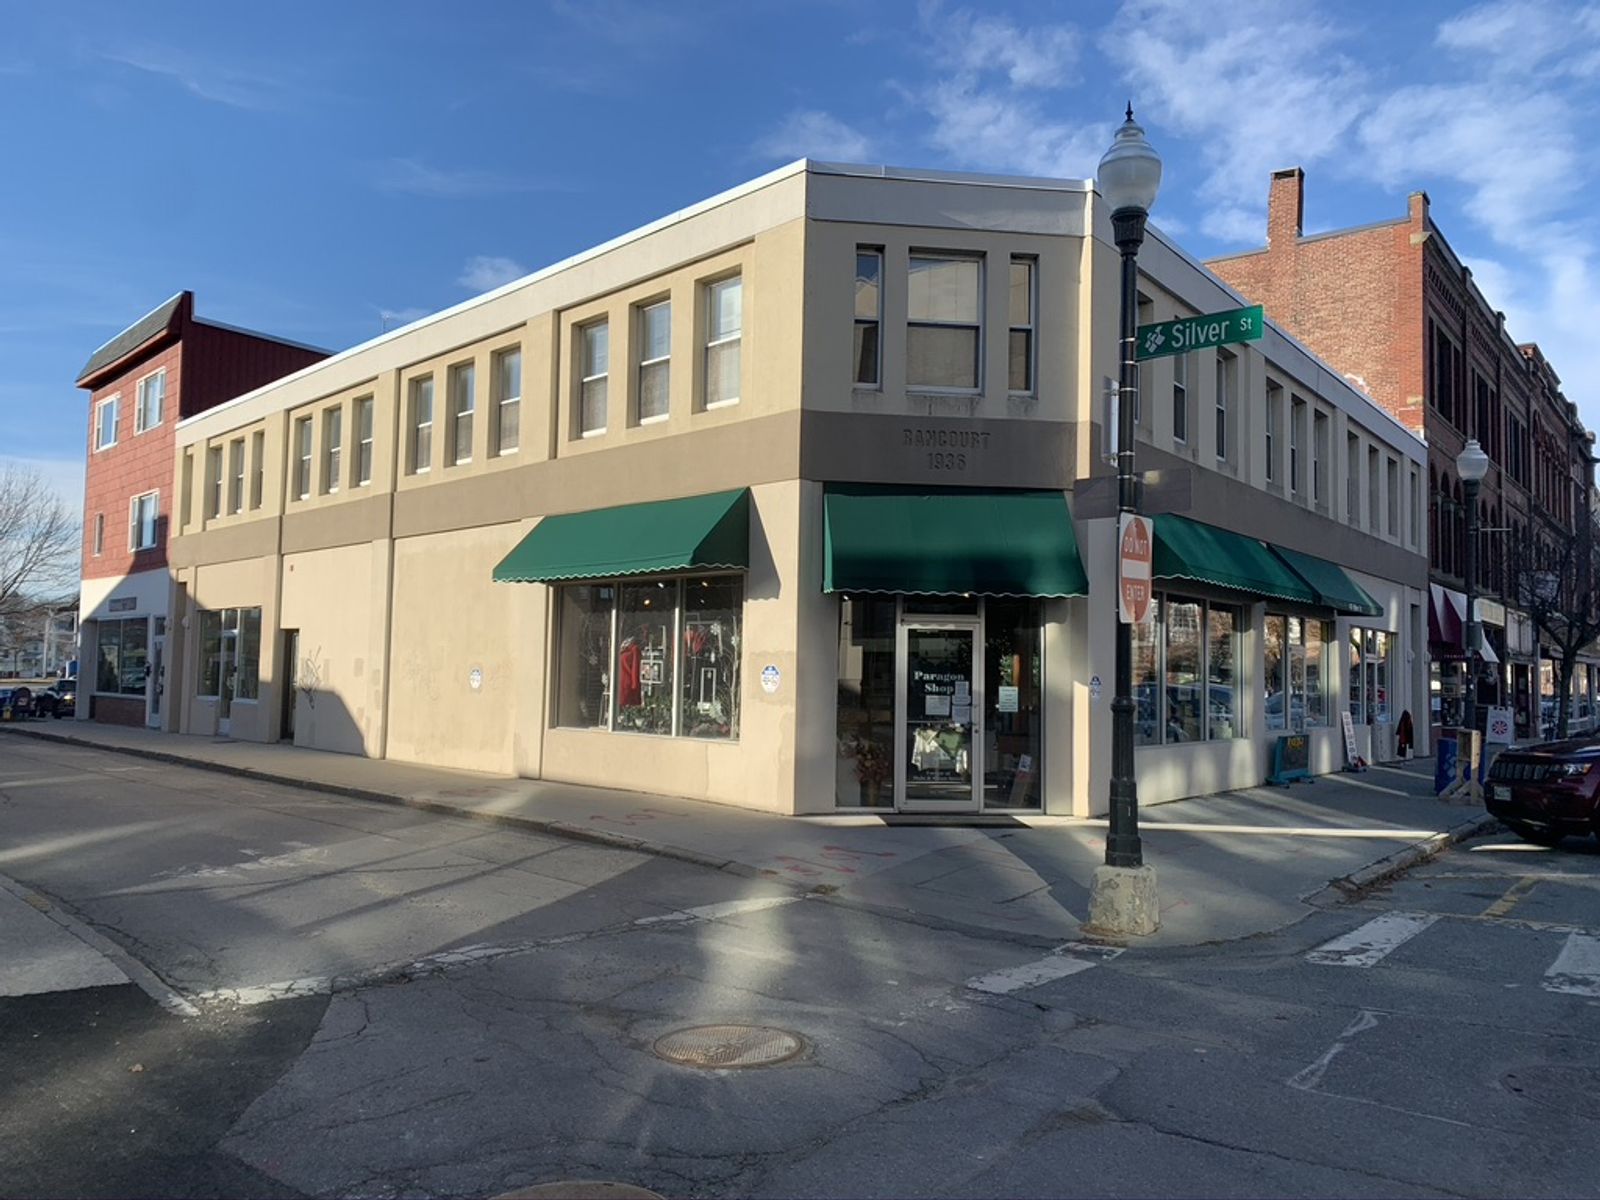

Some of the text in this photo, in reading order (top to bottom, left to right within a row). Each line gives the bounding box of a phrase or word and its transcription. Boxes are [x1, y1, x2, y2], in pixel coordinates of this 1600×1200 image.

[1171, 316, 1252, 348] Silver St
[903, 429, 991, 450] RANCOURT
[928, 452, 966, 471] 1936
[1126, 584, 1145, 601] ENTER
[913, 670, 965, 682] Paragon
[924, 683, 954, 695] Shop
